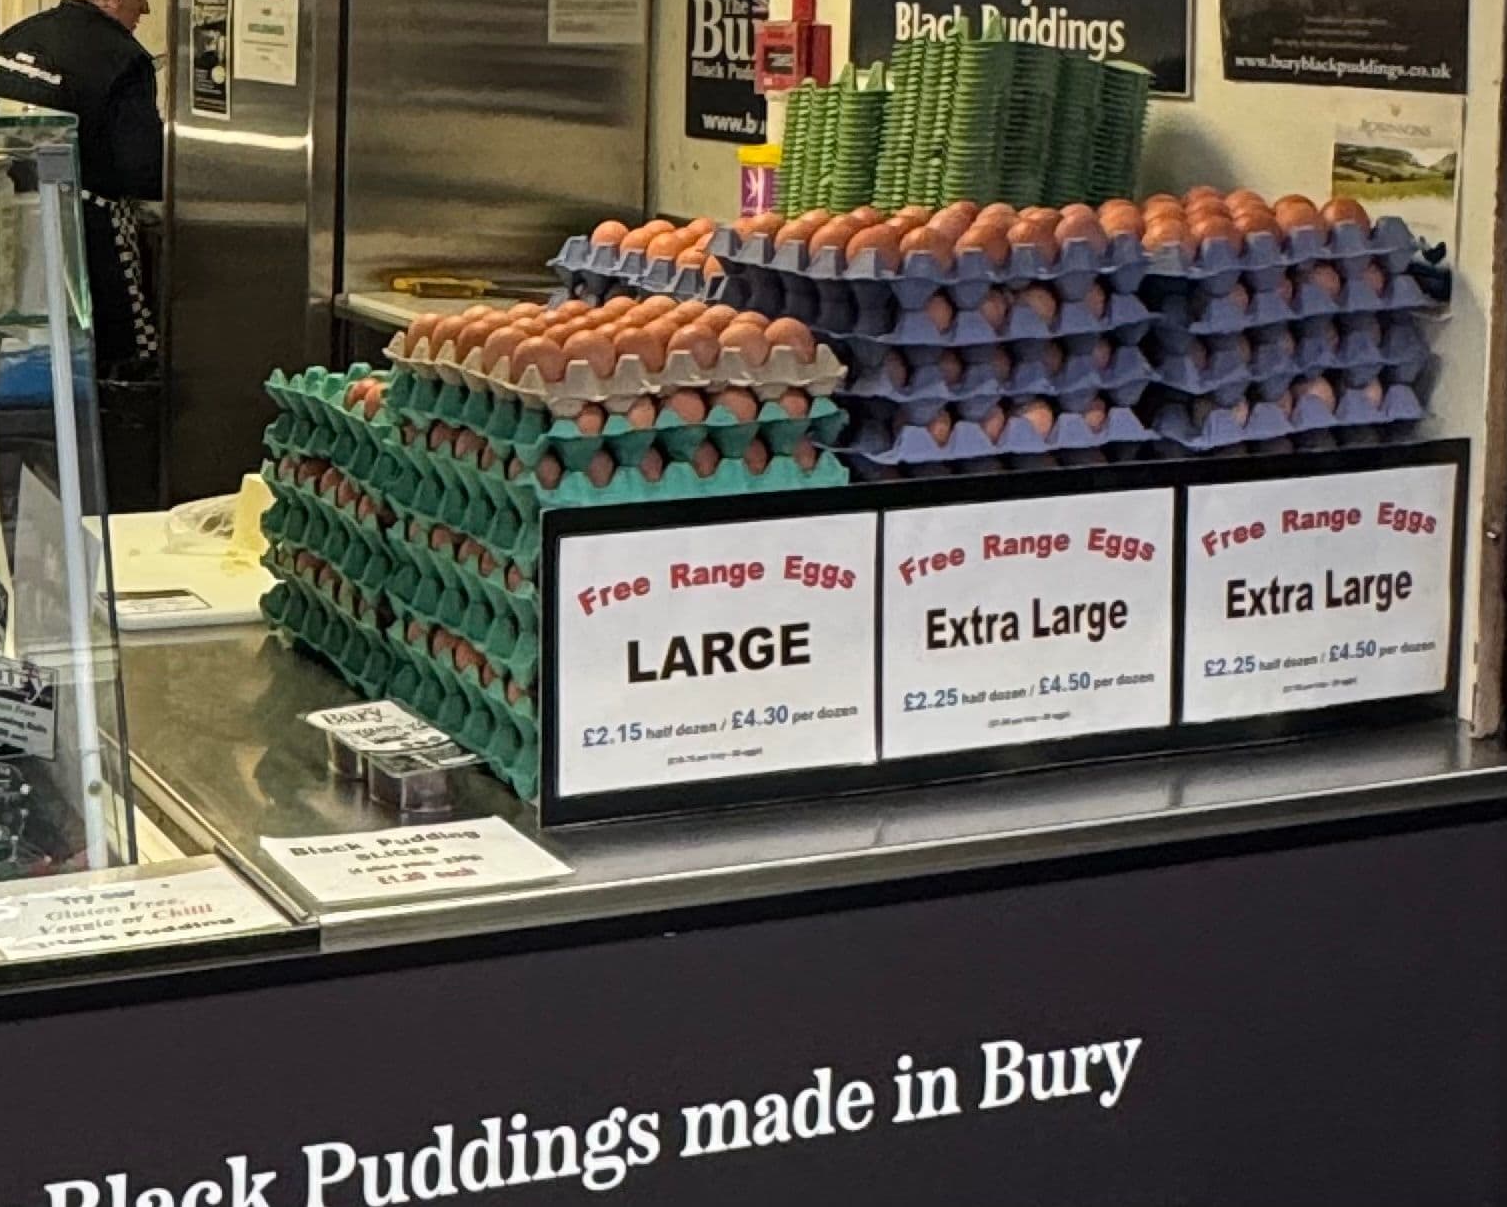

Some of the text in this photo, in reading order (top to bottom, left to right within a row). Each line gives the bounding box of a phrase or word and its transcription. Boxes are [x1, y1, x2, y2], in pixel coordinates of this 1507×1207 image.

[1200, 501, 1438, 558] Free Range Eggs
[897, 526, 1157, 587] Free Range Eggs
[577, 555, 857, 617] Free Range Eggs
[1225, 569, 1414, 620] Extra Large
[925, 597, 1129, 651] Extra Large
[627, 621, 812, 684] LARGE
[1204, 655, 1256, 678] £2.25
[1258, 658, 1282, 672] half
[1283, 654, 1319, 669] dozen
[1328, 639, 1378, 663] £4.50
[1379, 643, 1399, 658] per
[1400, 640, 1437, 655] dozen
[903, 687, 959, 712] £2.25
[961, 691, 988, 705] half
[988, 687, 1027, 703] dozen
[1039, 671, 1092, 696] £4.50
[1093, 675, 1114, 691] per
[1115, 672, 1156, 686] dozen
[582, 722, 643, 748] £2.15
[645, 724, 674, 740] half
[675, 722, 718, 738] dozen
[730, 705, 790, 731] £4.30
[791, 710, 815, 725] per
[816, 705, 859, 719] dozen
[289, 828, 482, 858] Black Pudding
[354, 844, 440, 862] SLICES
[302, 1106, 660, 1207] Puddings
[680, 1067, 876, 1158] made
[891, 1055, 962, 1123] in
[978, 1038, 1144, 1109] Bury
